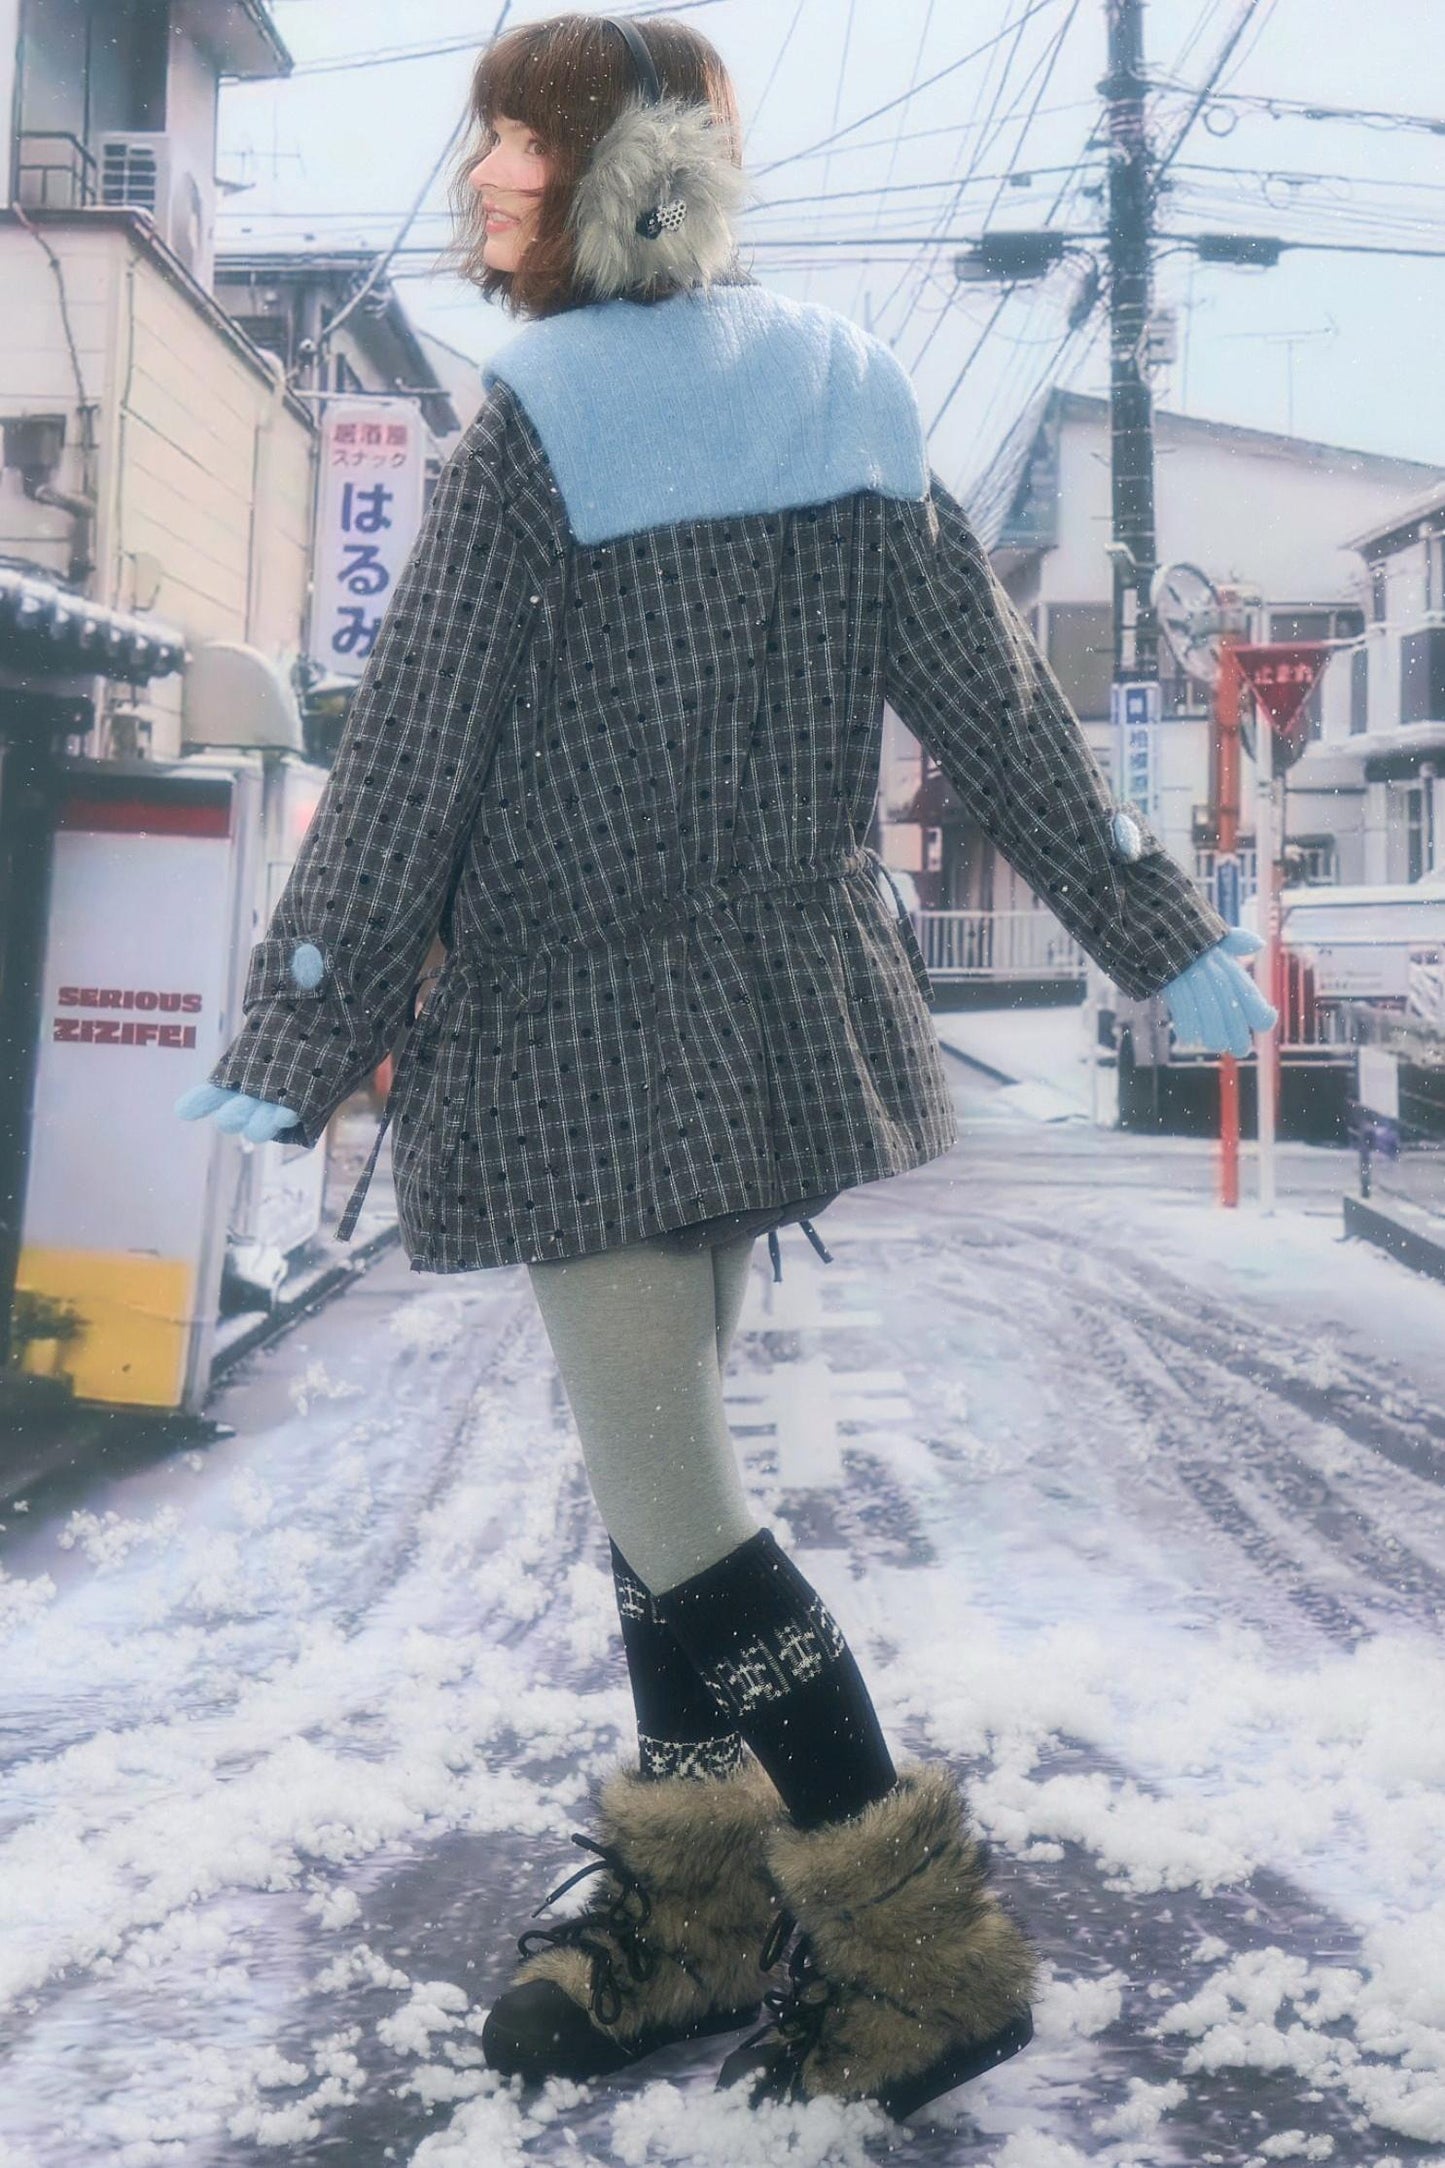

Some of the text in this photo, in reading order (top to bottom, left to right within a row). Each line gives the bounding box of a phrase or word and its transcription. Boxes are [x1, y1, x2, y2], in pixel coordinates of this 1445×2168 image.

[332, 449, 406, 468] スナック
[332, 482, 393, 658] はるみ
[58, 987, 202, 1012] SERIOUS
